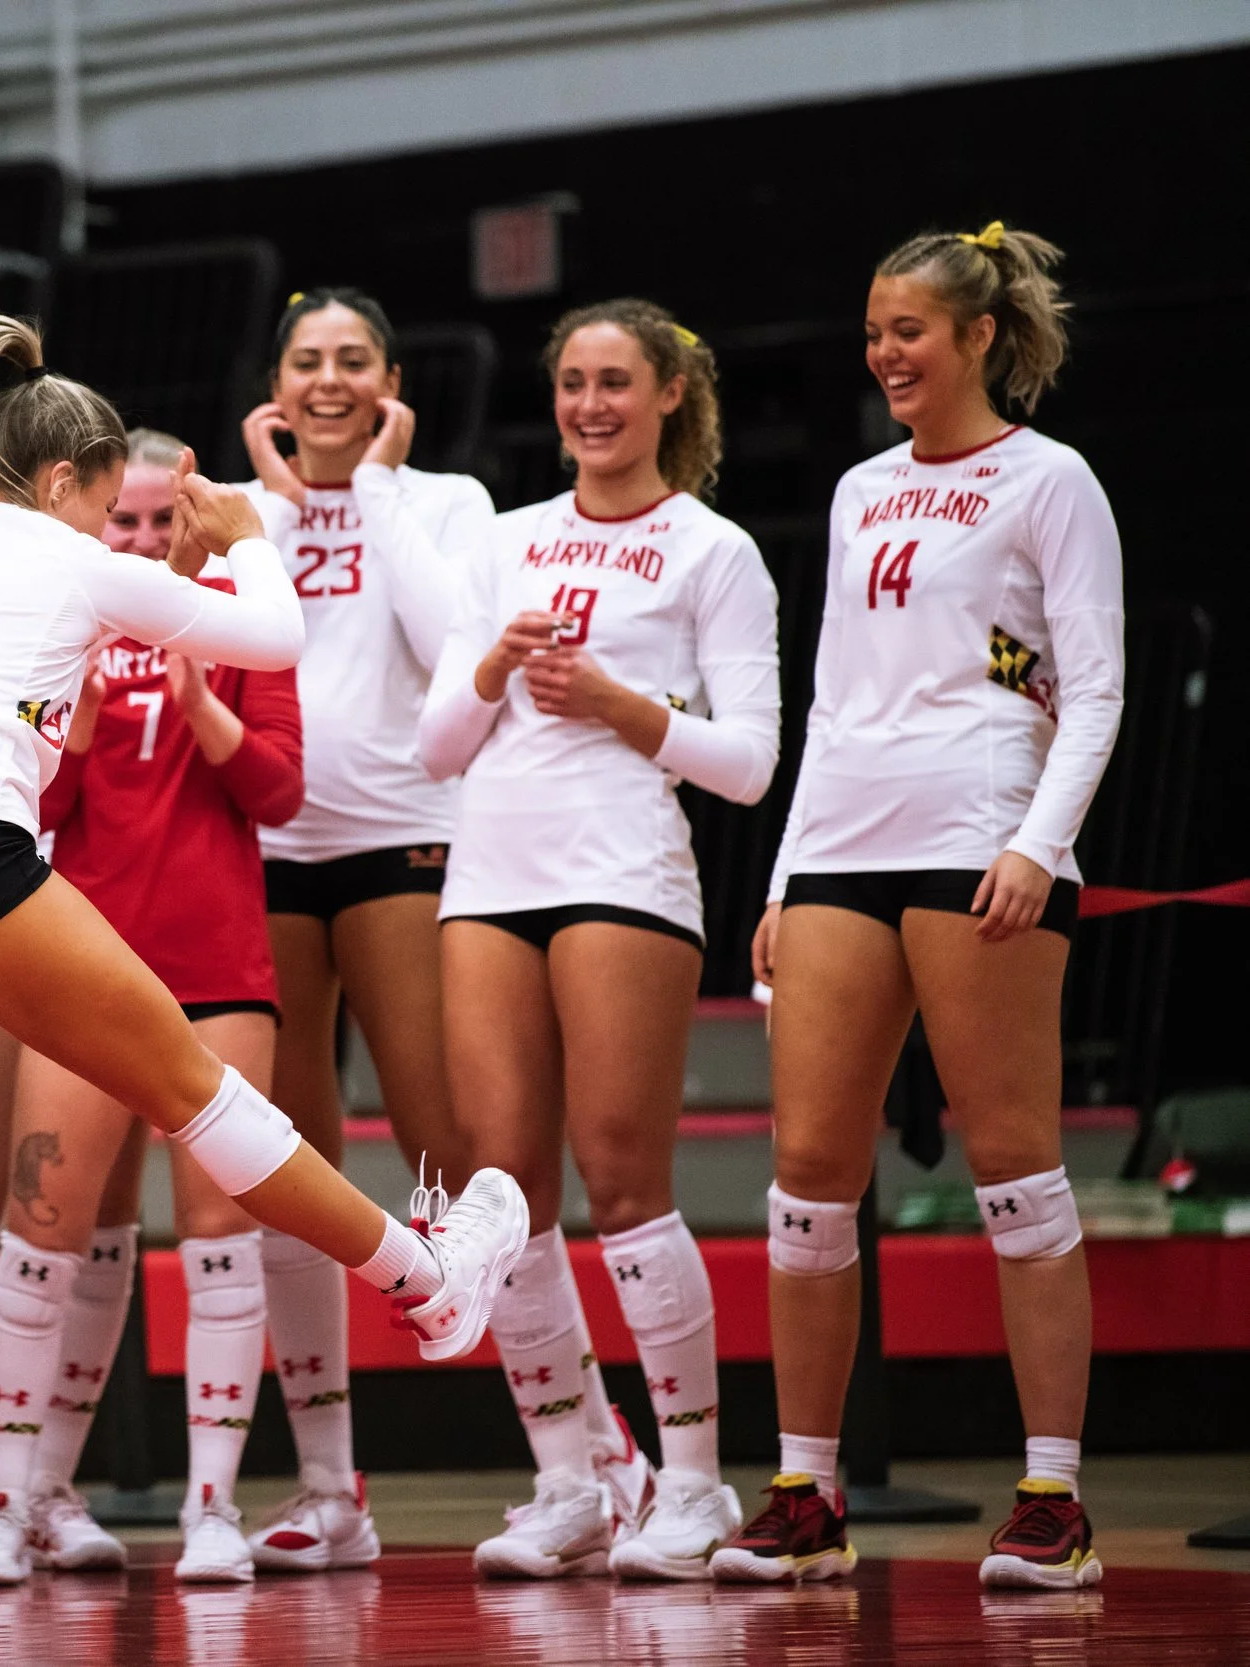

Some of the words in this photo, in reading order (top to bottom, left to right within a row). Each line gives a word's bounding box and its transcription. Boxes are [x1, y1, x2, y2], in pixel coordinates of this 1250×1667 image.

[857, 487, 989, 532] MARYLAND
[293, 542, 363, 599] 23
[519, 538, 664, 583] MARYLAND
[867, 540, 921, 610] 14
[127, 691, 164, 761] 7
